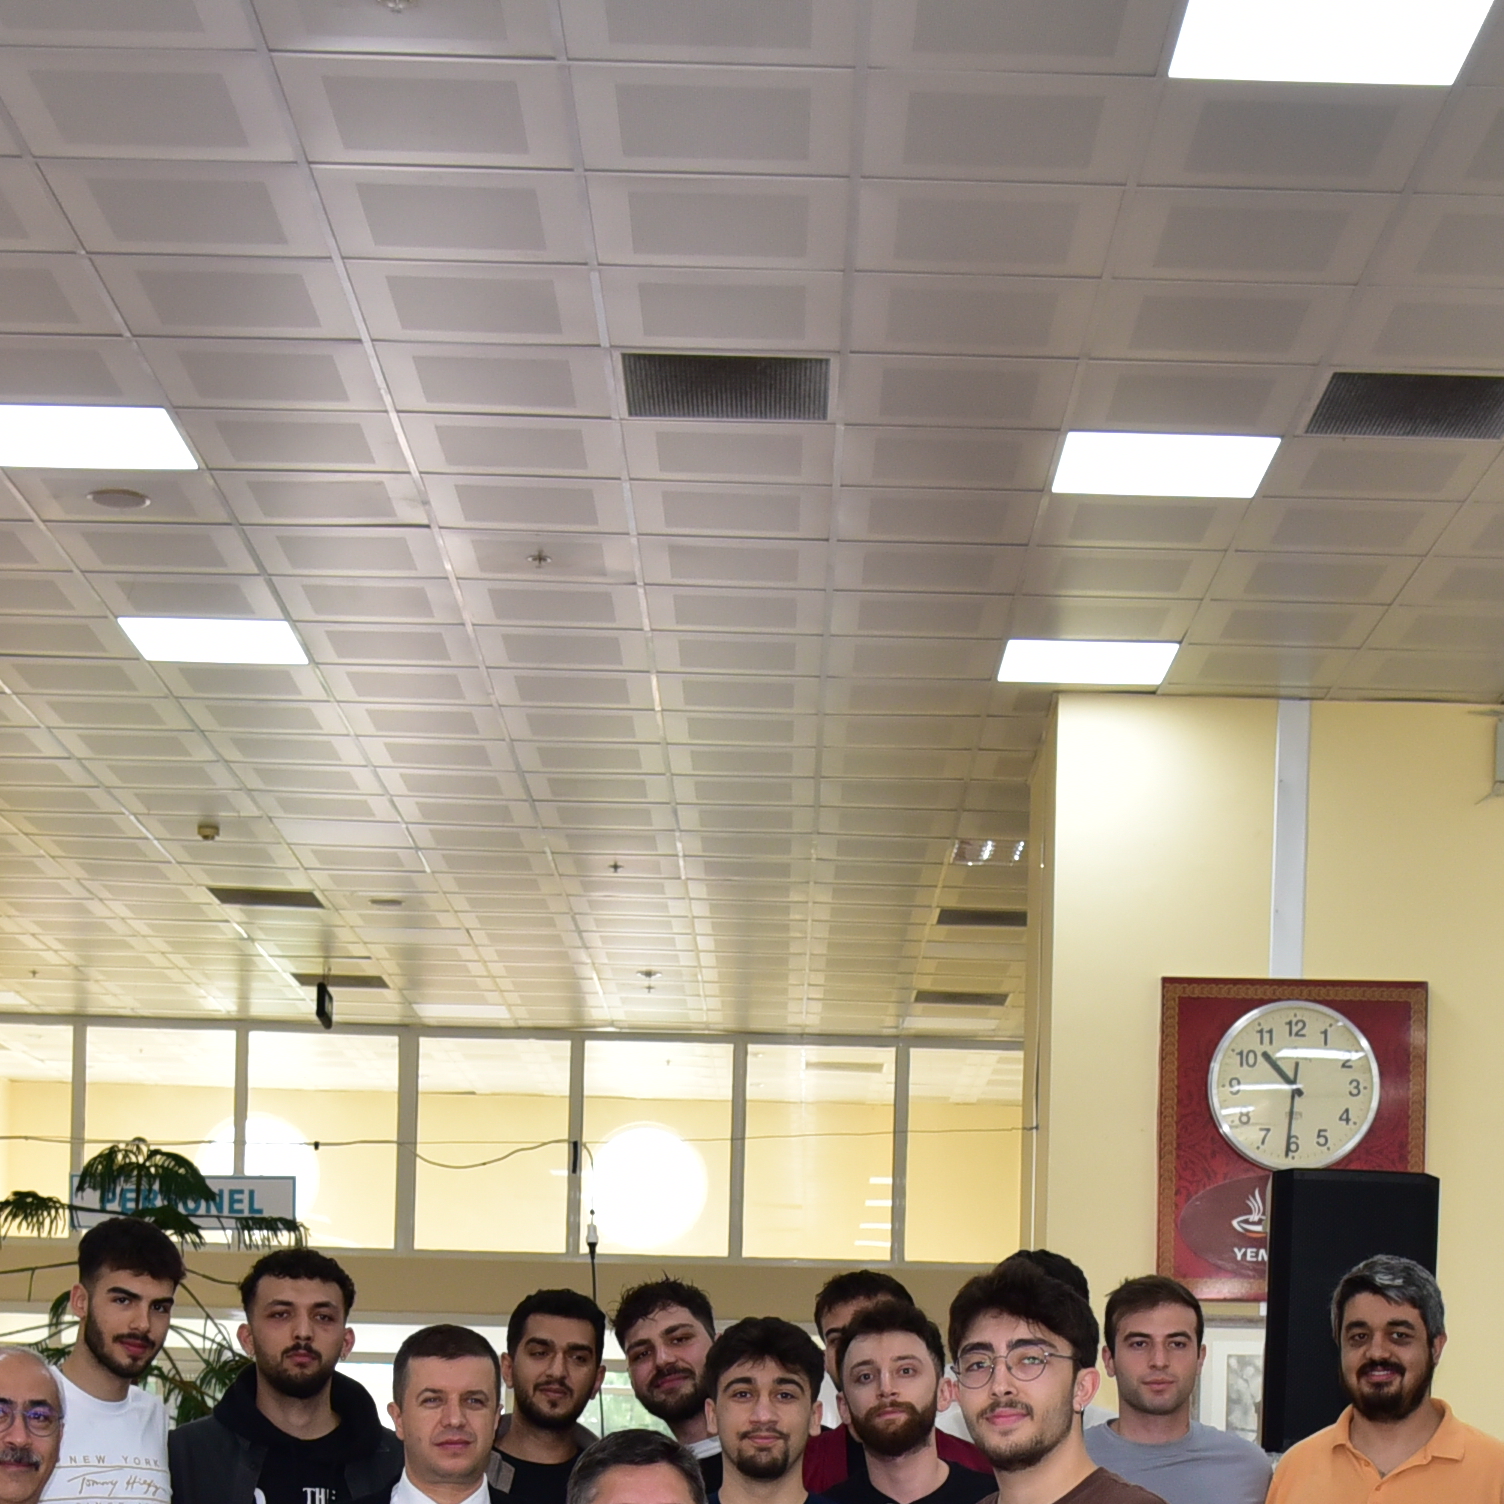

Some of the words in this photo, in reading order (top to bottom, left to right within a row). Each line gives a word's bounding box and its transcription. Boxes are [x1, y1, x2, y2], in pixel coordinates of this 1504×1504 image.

[1256, 1027, 1274, 1046] 11
[1284, 1019, 1307, 1038] 12
[1319, 1028, 1329, 1046] 1
[1235, 1049, 1258, 1068] 10
[1228, 1077, 1242, 1096] 9
[1348, 1079, 1362, 1097] 3
[1338, 1108, 1352, 1126] 4
[1258, 1128, 1271, 1146] 7
[1287, 1135, 1300, 1153] 6
[1315, 1129, 1329, 1147] 5
[100, 1188, 264, 1215] PERONEL
[69, 1455, 106, 1464] NEW
[121, 1455, 161, 1468] YORK
